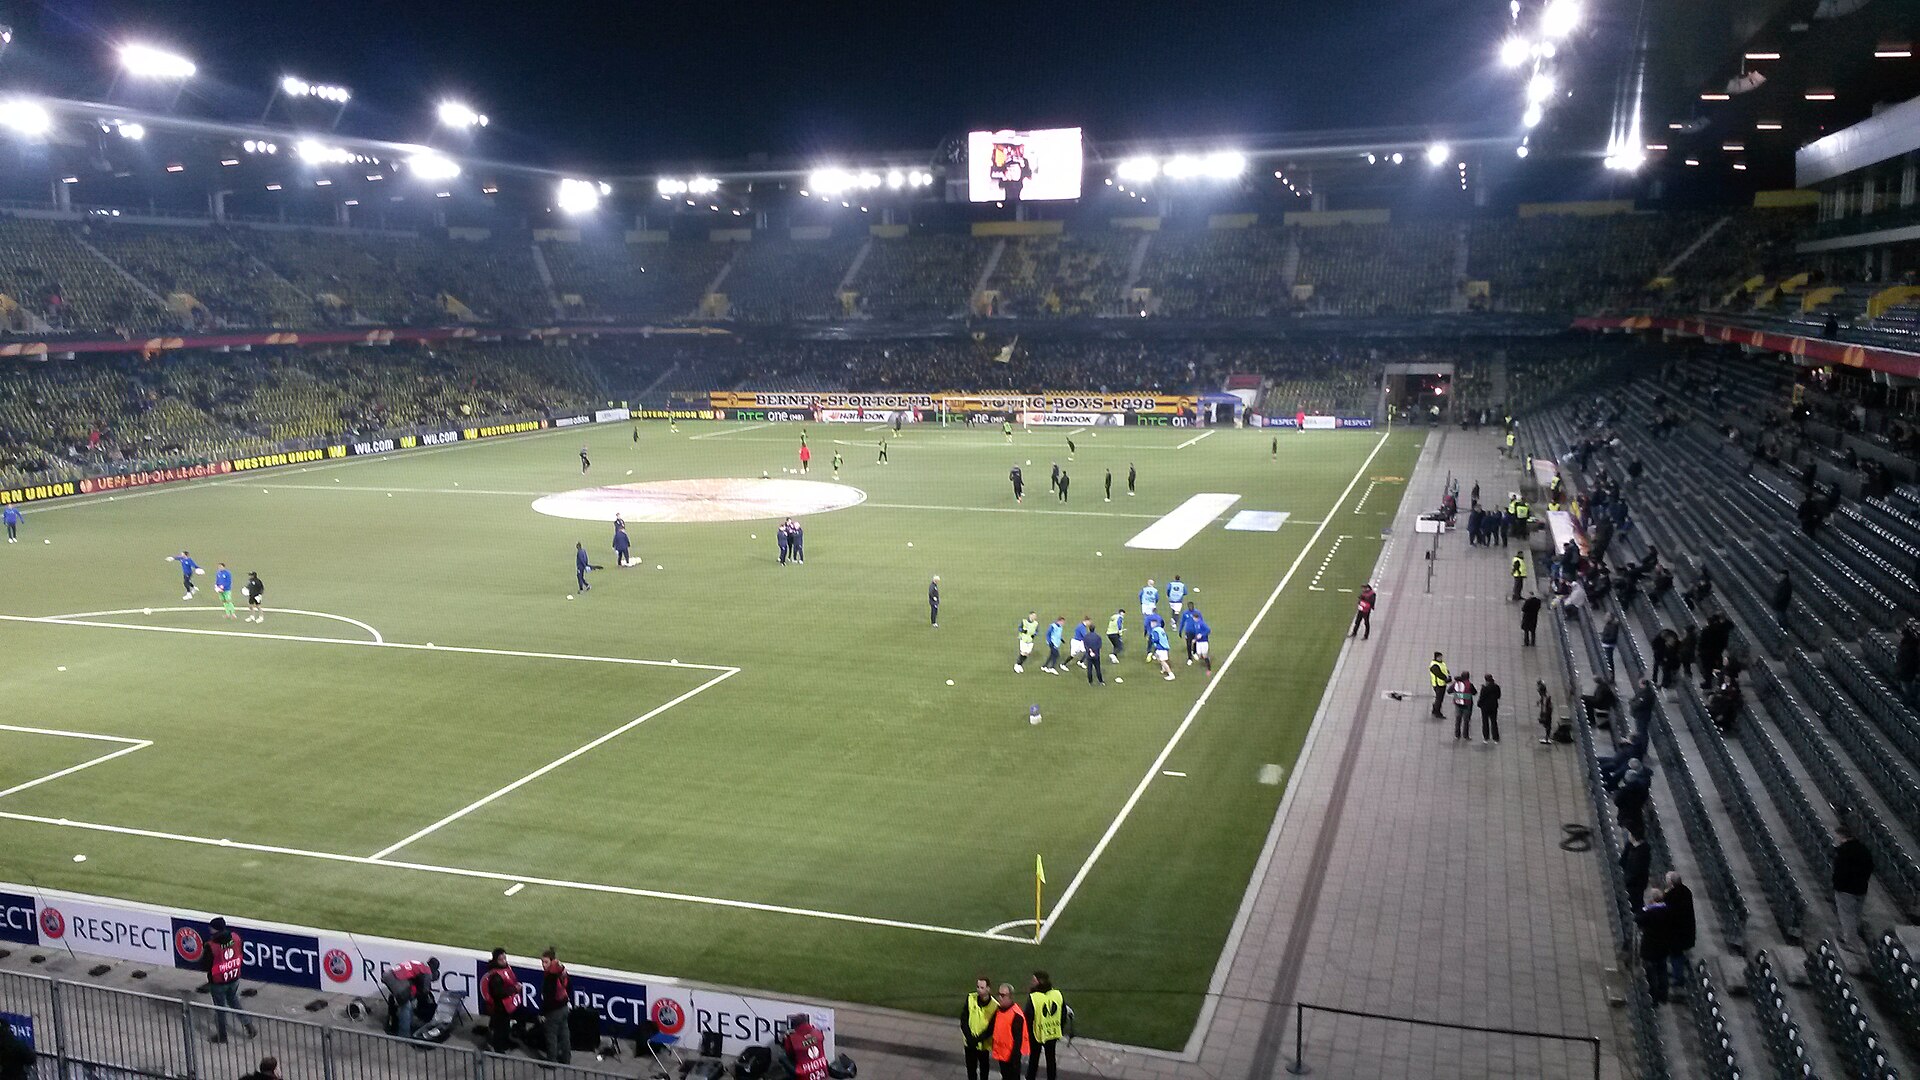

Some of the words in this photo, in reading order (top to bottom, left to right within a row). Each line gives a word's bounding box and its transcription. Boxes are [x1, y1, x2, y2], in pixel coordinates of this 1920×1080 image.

[755, 394, 822, 406] BERNER
[827, 394, 932, 407] SPORTCLUB
[1051, 397, 1104, 410] BOYS
[480, 423, 515, 438] WESTERN
[515, 420, 539, 433] UNION
[233, 453, 288, 472] WESTERN
[288, 448, 323, 464] UNION
[25, 482, 74, 501] UNION
[73, 916, 170, 951] RESPECT
